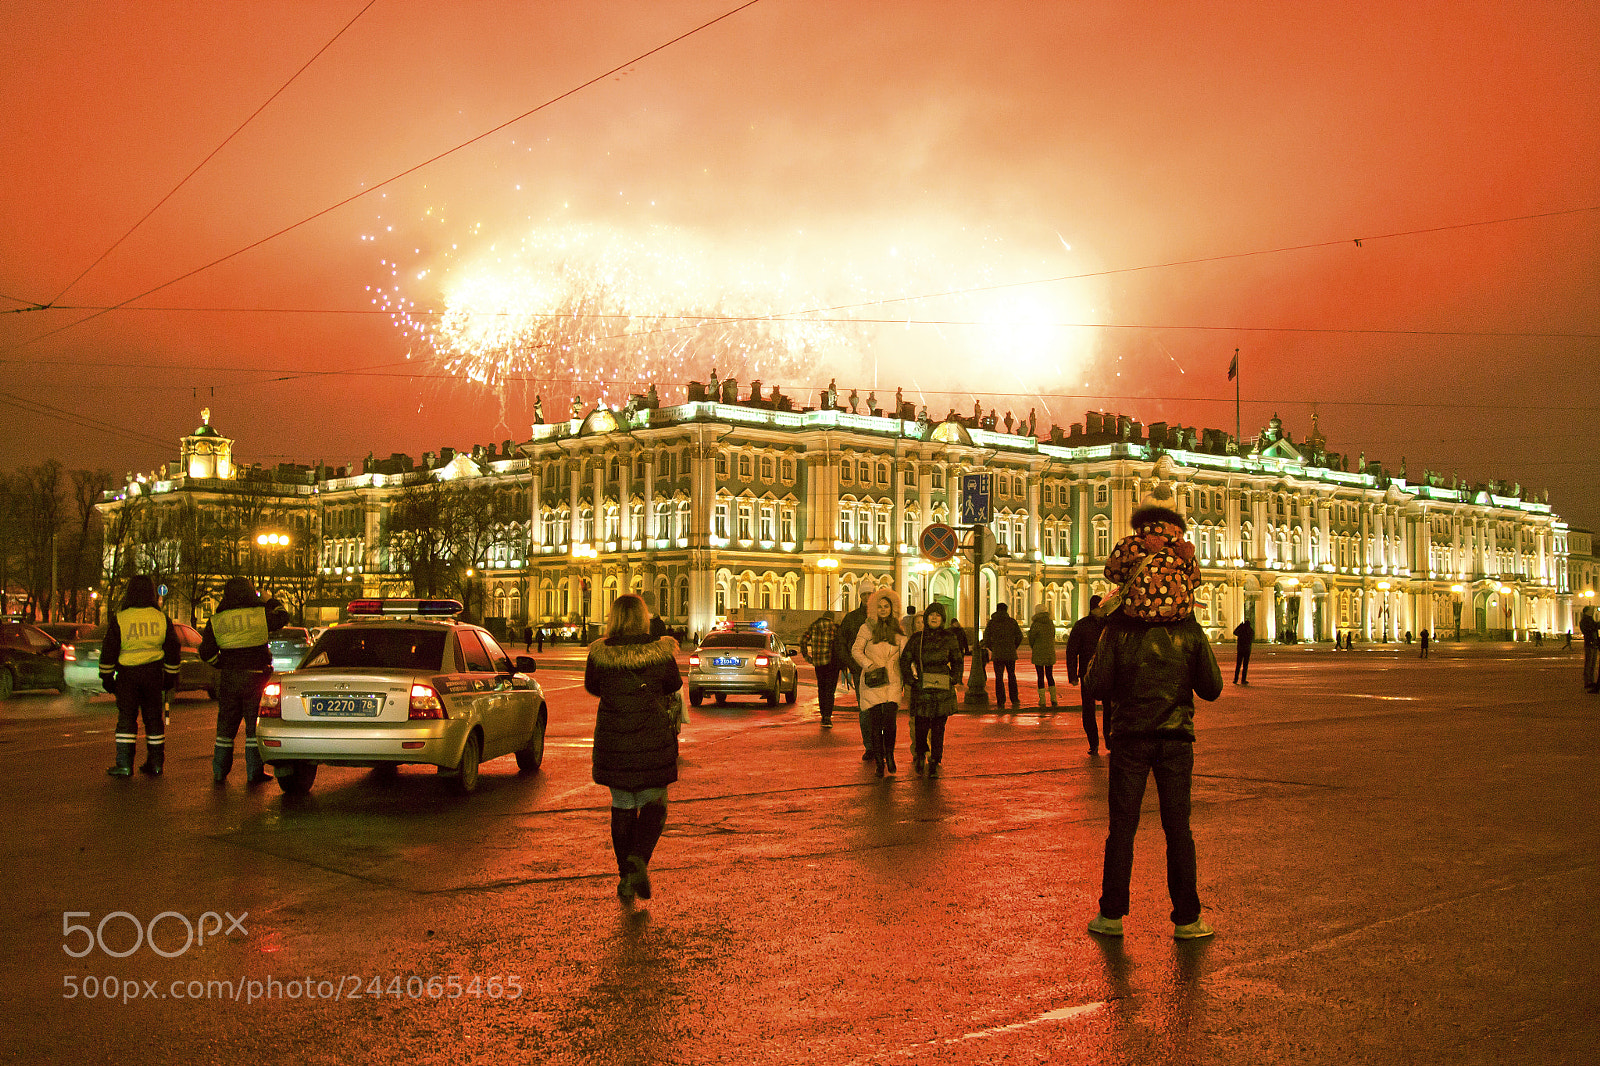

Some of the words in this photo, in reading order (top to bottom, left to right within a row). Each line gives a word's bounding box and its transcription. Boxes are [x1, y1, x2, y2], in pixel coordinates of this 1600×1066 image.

[127, 621, 160, 640] ДПС
[327, 700, 355, 712] 2270
[362, 700, 373, 709] 78
